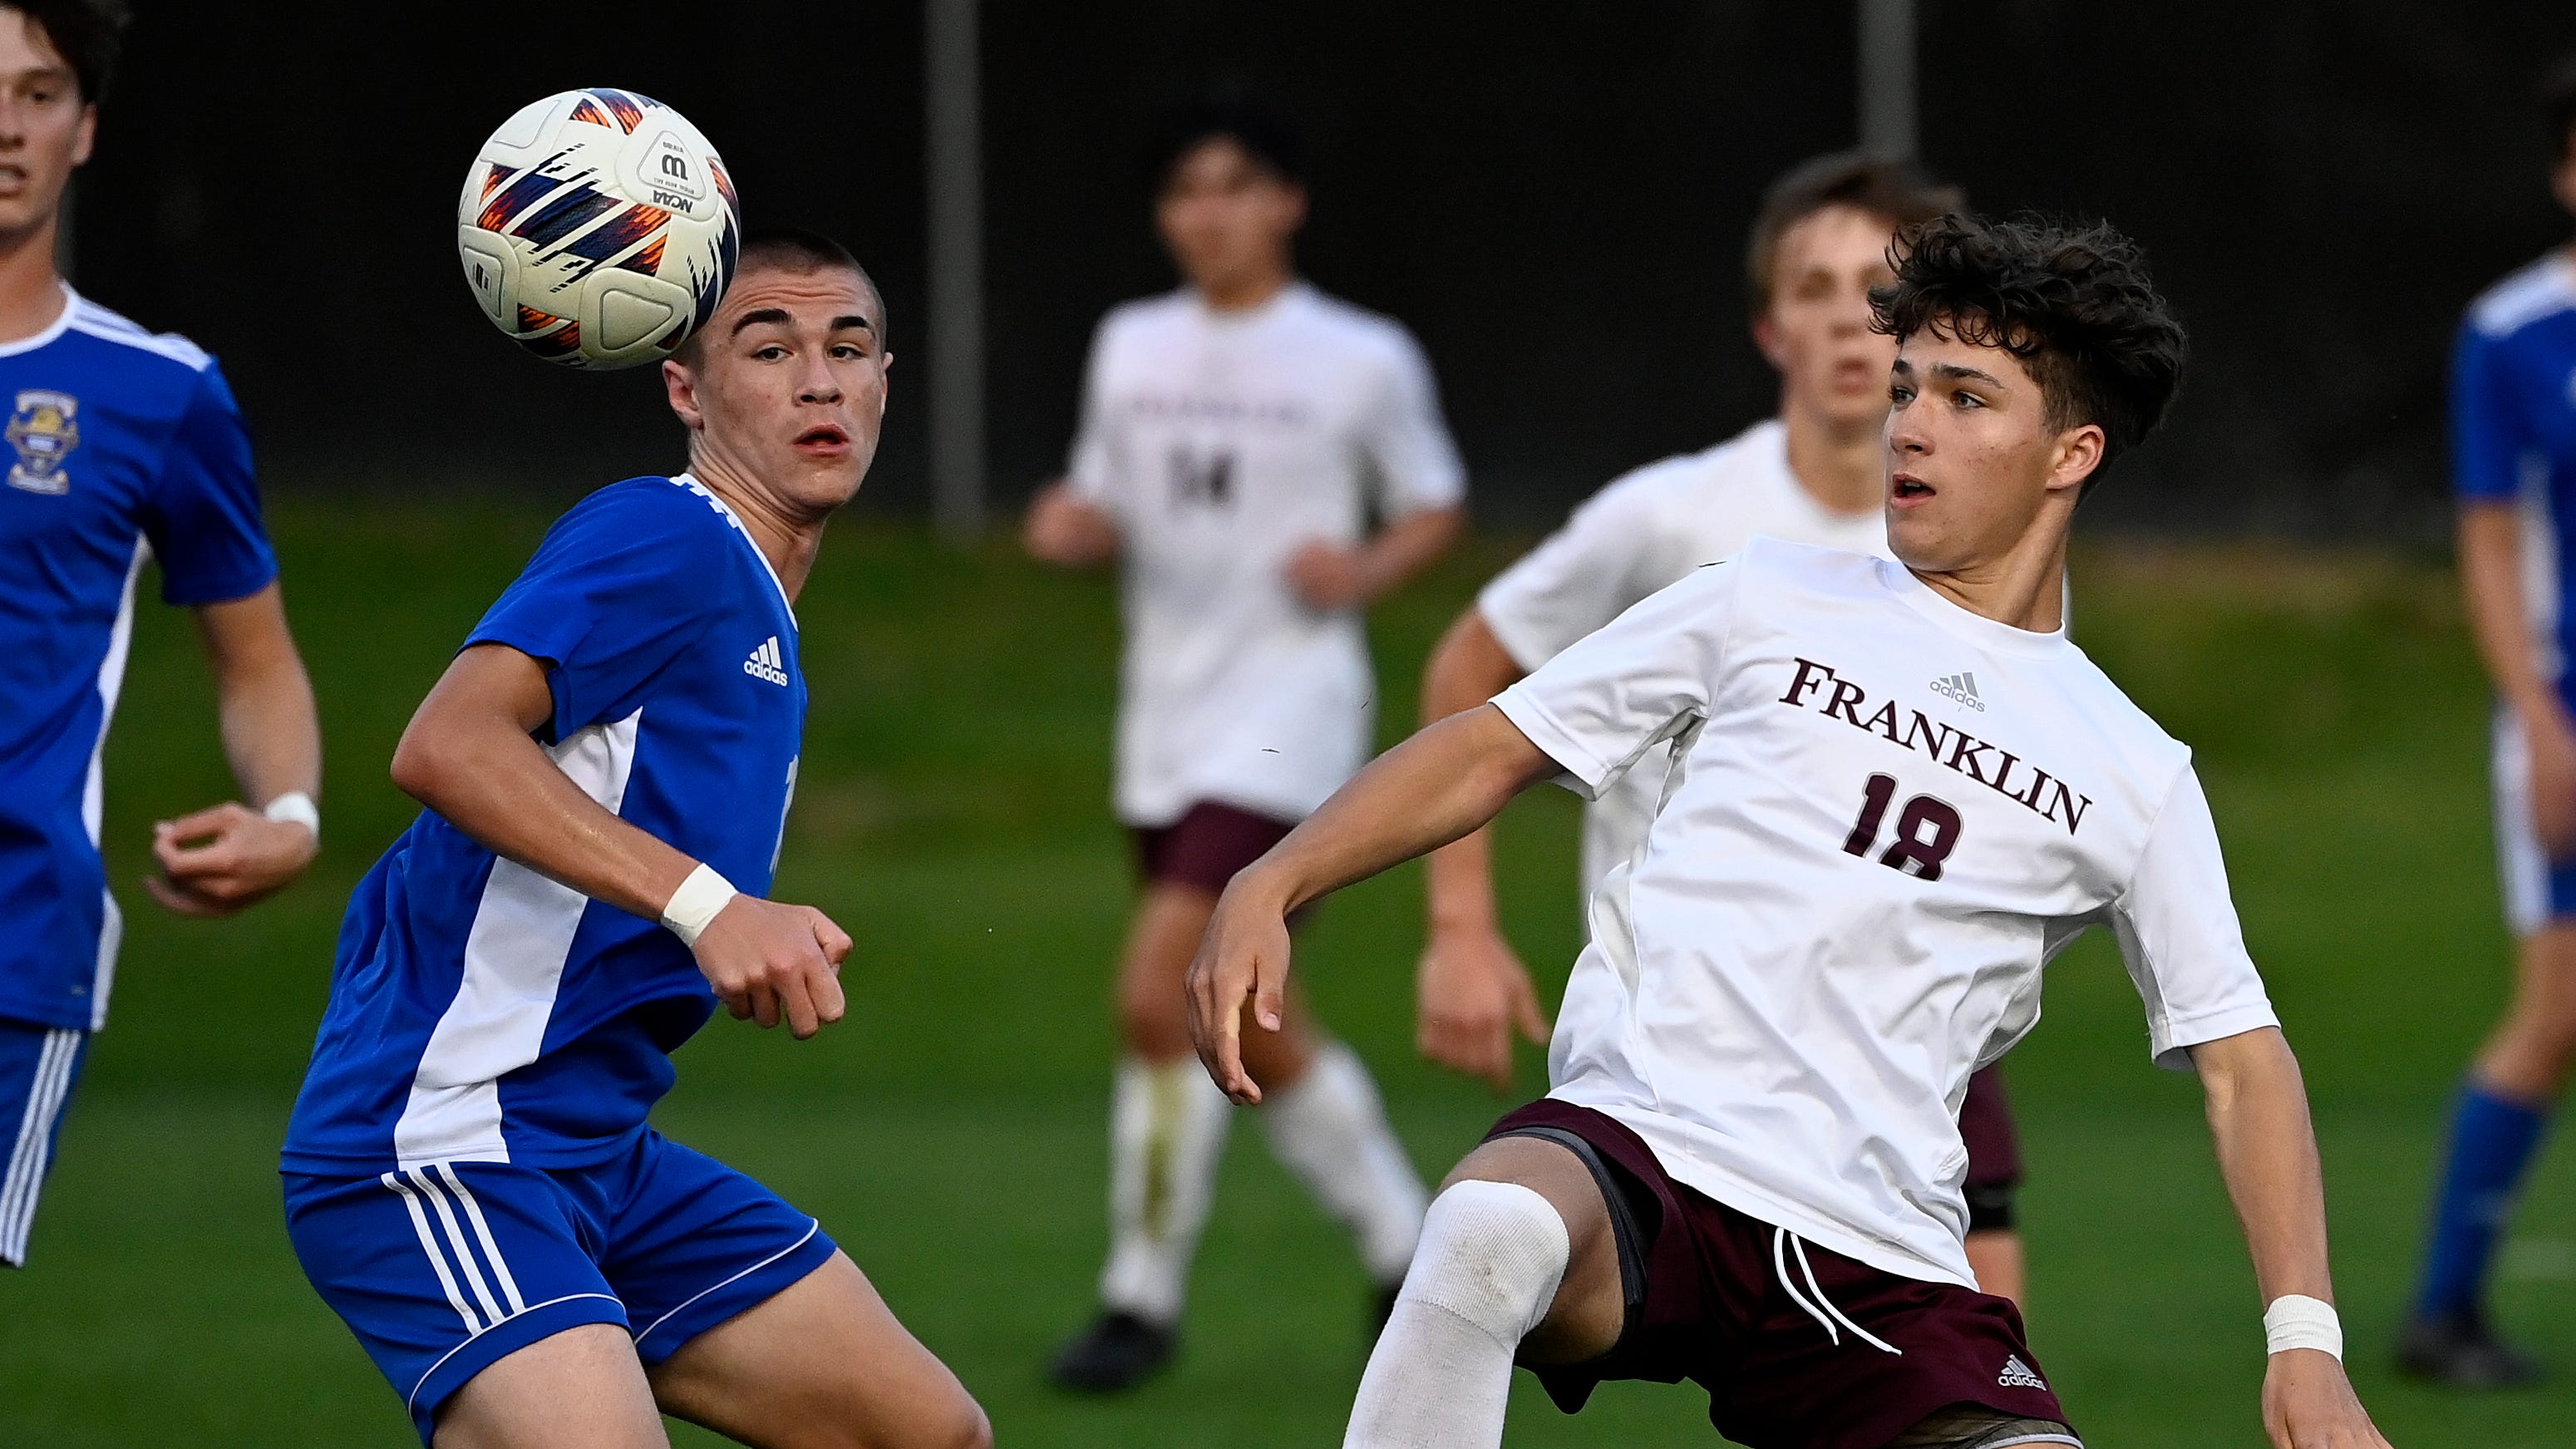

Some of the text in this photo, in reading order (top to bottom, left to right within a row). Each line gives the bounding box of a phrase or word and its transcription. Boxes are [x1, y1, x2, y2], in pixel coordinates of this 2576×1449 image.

[653, 190, 692, 213] NCAA
[743, 660, 788, 688] adidas
[1928, 678, 1986, 713] adidas
[1778, 656, 2093, 836] FRANKLIN
[1840, 771, 1965, 883] 18
